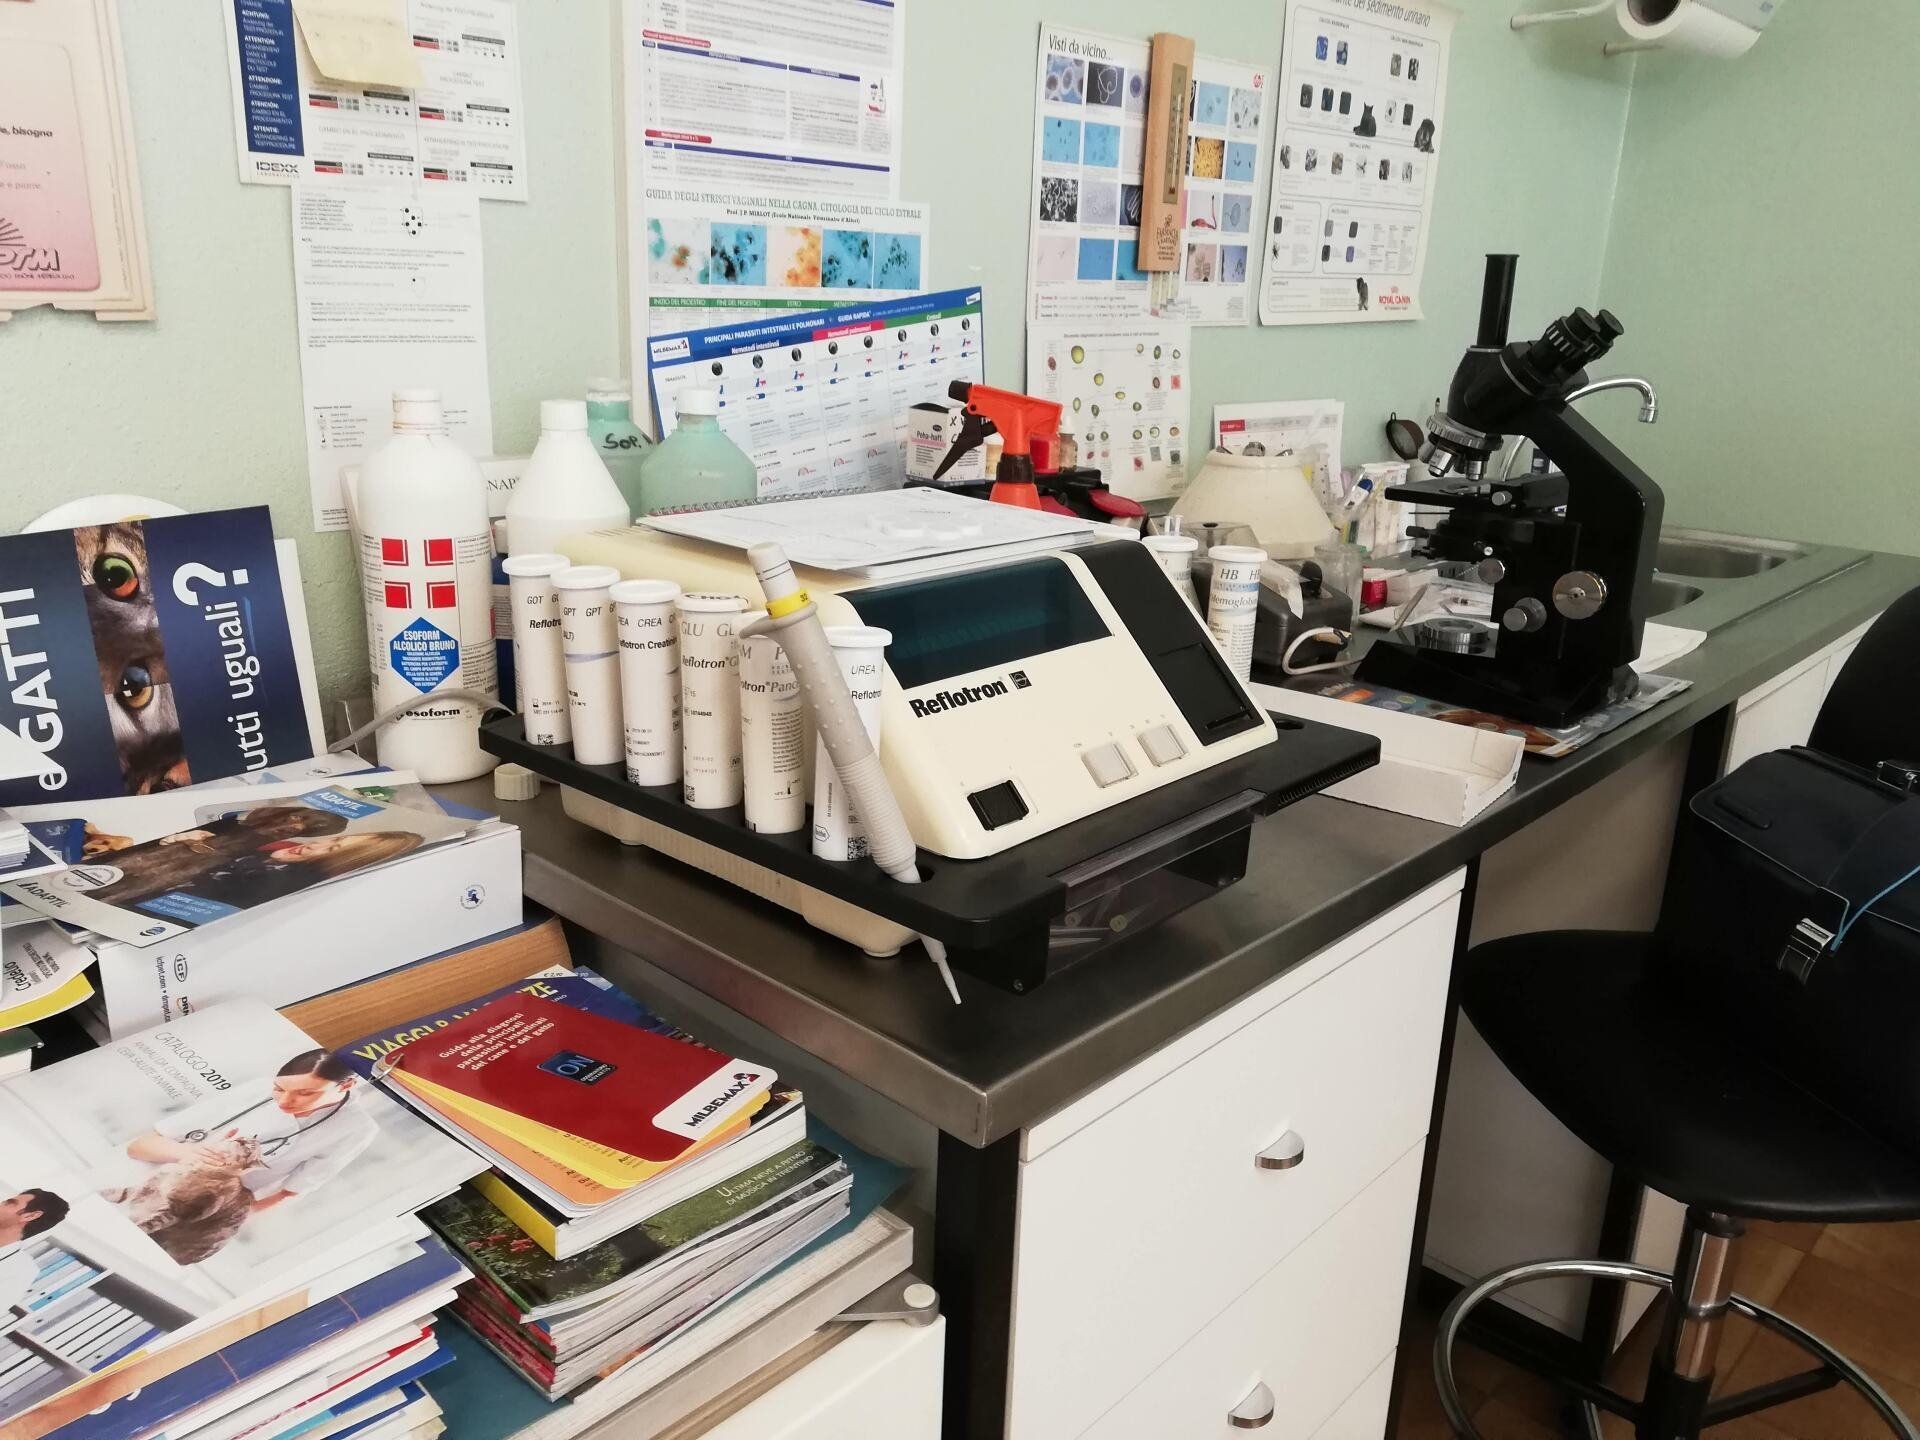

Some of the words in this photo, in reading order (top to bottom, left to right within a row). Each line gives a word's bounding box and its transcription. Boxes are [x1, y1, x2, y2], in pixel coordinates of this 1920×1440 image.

[1366, 0, 1403, 20] sedimento
[1404, 8, 1431, 29] urinario
[1049, 33, 1068, 52] Visti
[1068, 39, 1079, 54] da
[12, 126, 53, 138] bisogna
[256, 161, 299, 174] IDEXX
[646, 188, 673, 201] GUIDA
[674, 191, 700, 203] DEGLI
[769, 197, 792, 210] NELLA
[860, 204, 874, 215] DEL
[874, 205, 895, 217] CICLO
[838, 314, 853, 322] GUIDA
[704, 333, 734, 344] PRINCIPALI
[734, 329, 761, 339] PARASSITI
[761, 324, 792, 336] INTESTINALI
[916, 430, 943, 441] Peha-haft
[1220, 568, 1239, 580] HB
[527, 595, 544, 605] GOT
[563, 607, 576, 616] GPT
[586, 607, 602, 617] GPT
[637, 617, 662, 628] CREA
[404, 630, 440, 640] ESOFORM
[681, 621, 704, 636] GLU
[393, 640, 428, 651] ALCOLICO
[429, 640, 456, 651] BRUNO
[0, 588, 63, 752] GATTI
[851, 664, 876, 675] UREA
[909, 678, 1008, 718] Reflotron
[406, 708, 460, 717] esoform
[227, 711, 268, 771] utti
[26, 882, 67, 908] ADAPTIL
[5, 961, 32, 991] Credelio
[439, 1043, 469, 1058] Guida
[468, 1033, 488, 1044] alla
[486, 1012, 525, 1034] diagnosi
[457, 1040, 507, 1070] parassitosi
[504, 1017, 549, 1042] intestinali
[460, 1043, 486, 1057] delle
[484, 1021, 526, 1045] principali
[471, 1060, 489, 1071] del
[487, 1048, 510, 1062] cane
[517, 1035, 534, 1045] del
[532, 1022, 556, 1037] gatto
[155, 1031, 209, 1071] CATALOGO
[200, 1068, 232, 1091] 2019
[684, 1081, 750, 1127] MILBEMAX
[716, 1176, 755, 1198] ULTIMA
[754, 1166, 776, 1184] NEVE
[780, 1150, 807, 1167] RITMO
[726, 1197, 735, 1206] DI
[735, 1180, 769, 1201] MUSICA
[768, 1175, 777, 1184] IN
[776, 1155, 815, 1179] TRENTINO
